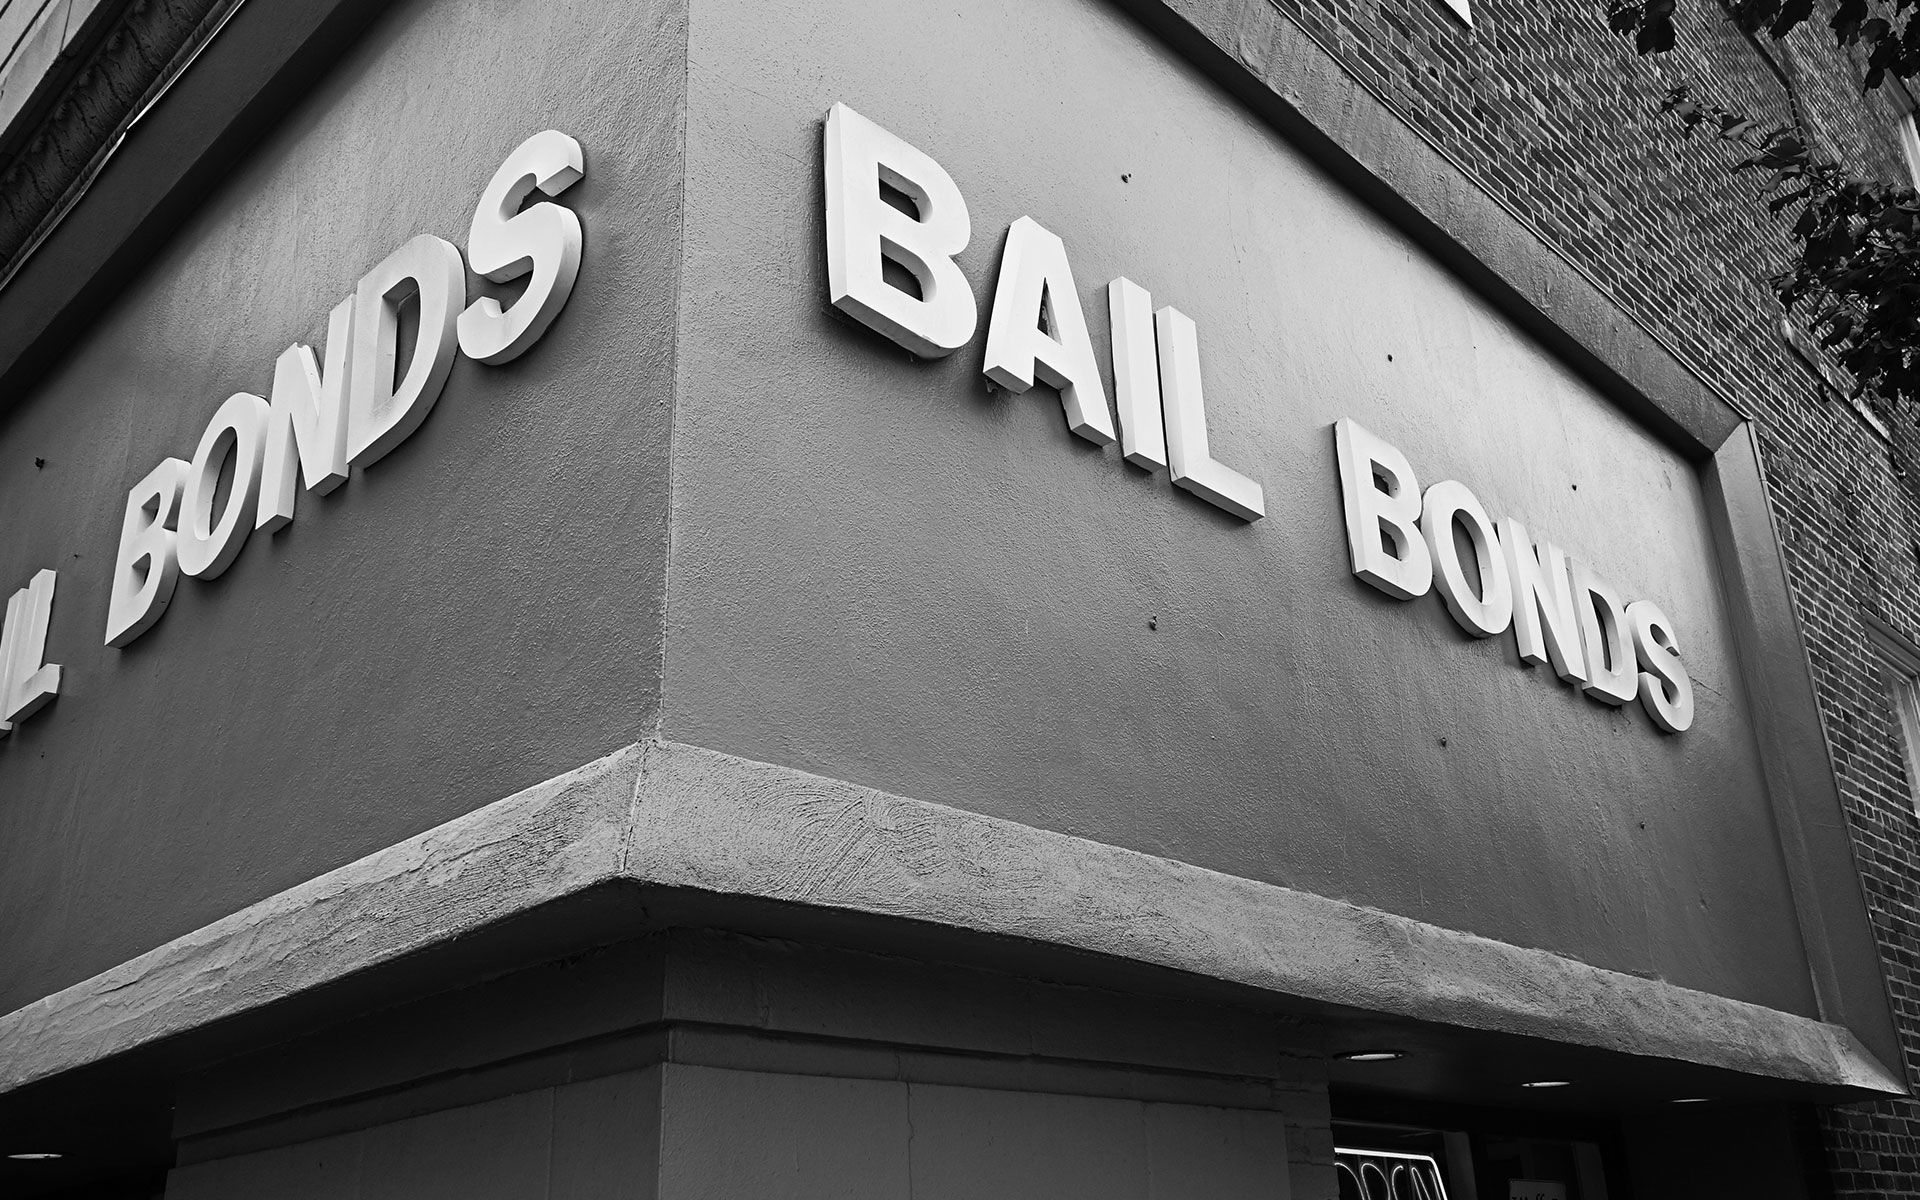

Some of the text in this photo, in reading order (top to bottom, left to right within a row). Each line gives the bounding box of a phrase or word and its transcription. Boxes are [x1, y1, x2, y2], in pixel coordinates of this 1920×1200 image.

[104, 130, 584, 649] BONDS
[823, 101, 1694, 733] BAIL BONDS
